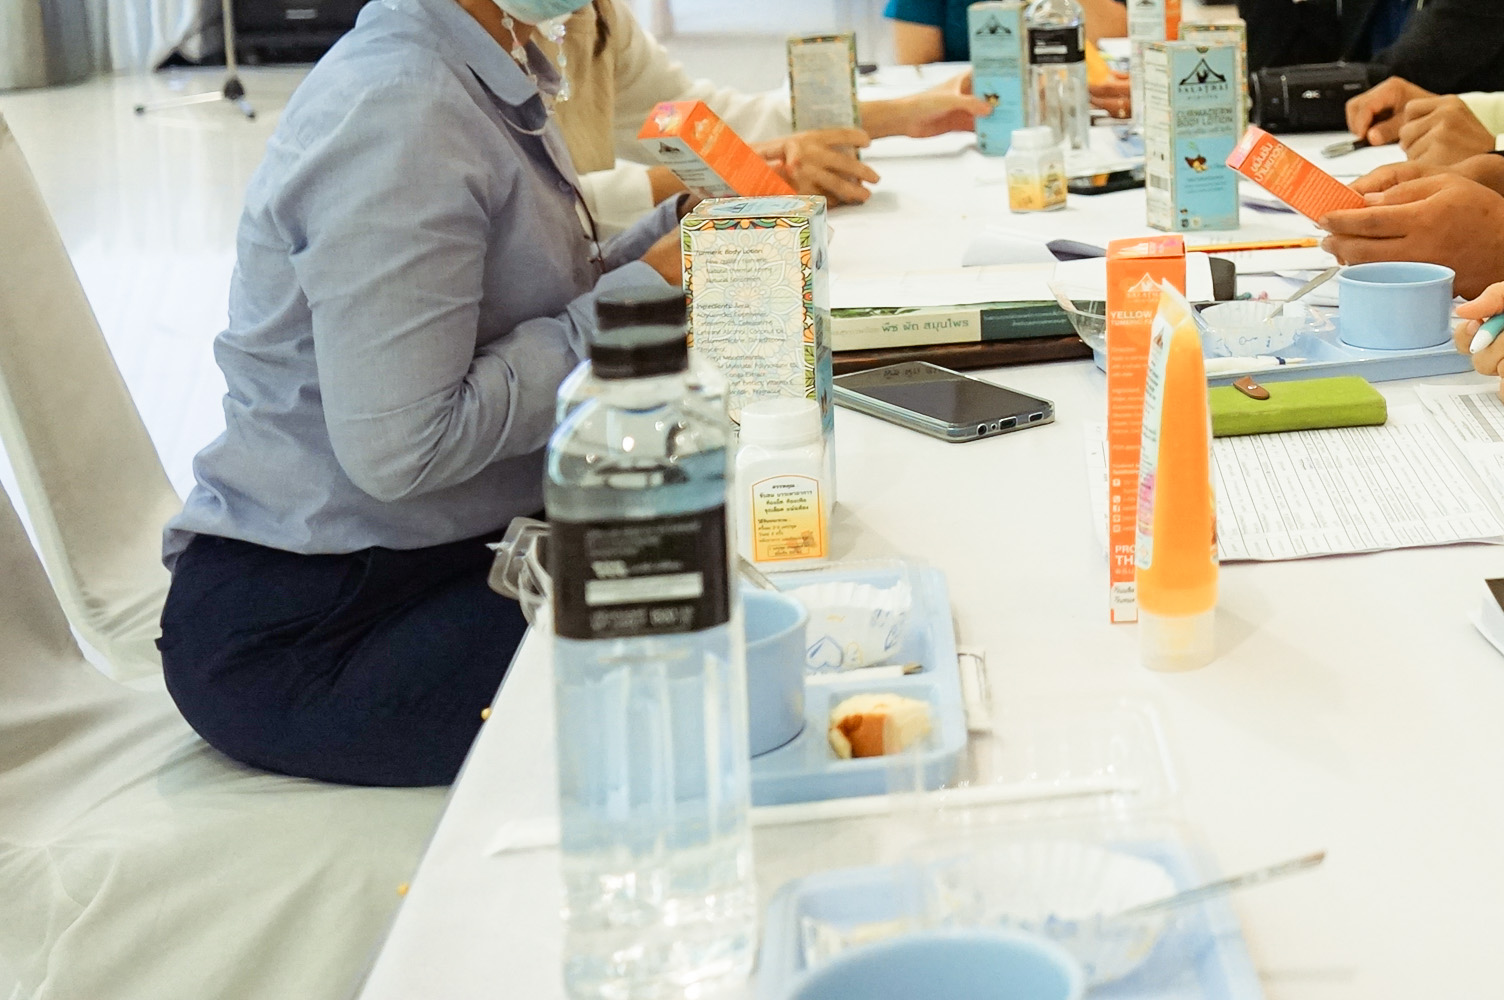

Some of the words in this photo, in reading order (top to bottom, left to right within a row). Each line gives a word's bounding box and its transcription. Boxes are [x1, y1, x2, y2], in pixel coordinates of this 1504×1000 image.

[1111, 311, 1152, 319] YELLOW
[924, 318, 969, 332] สมุนไพร
[1114, 544, 1135, 553] PRO
